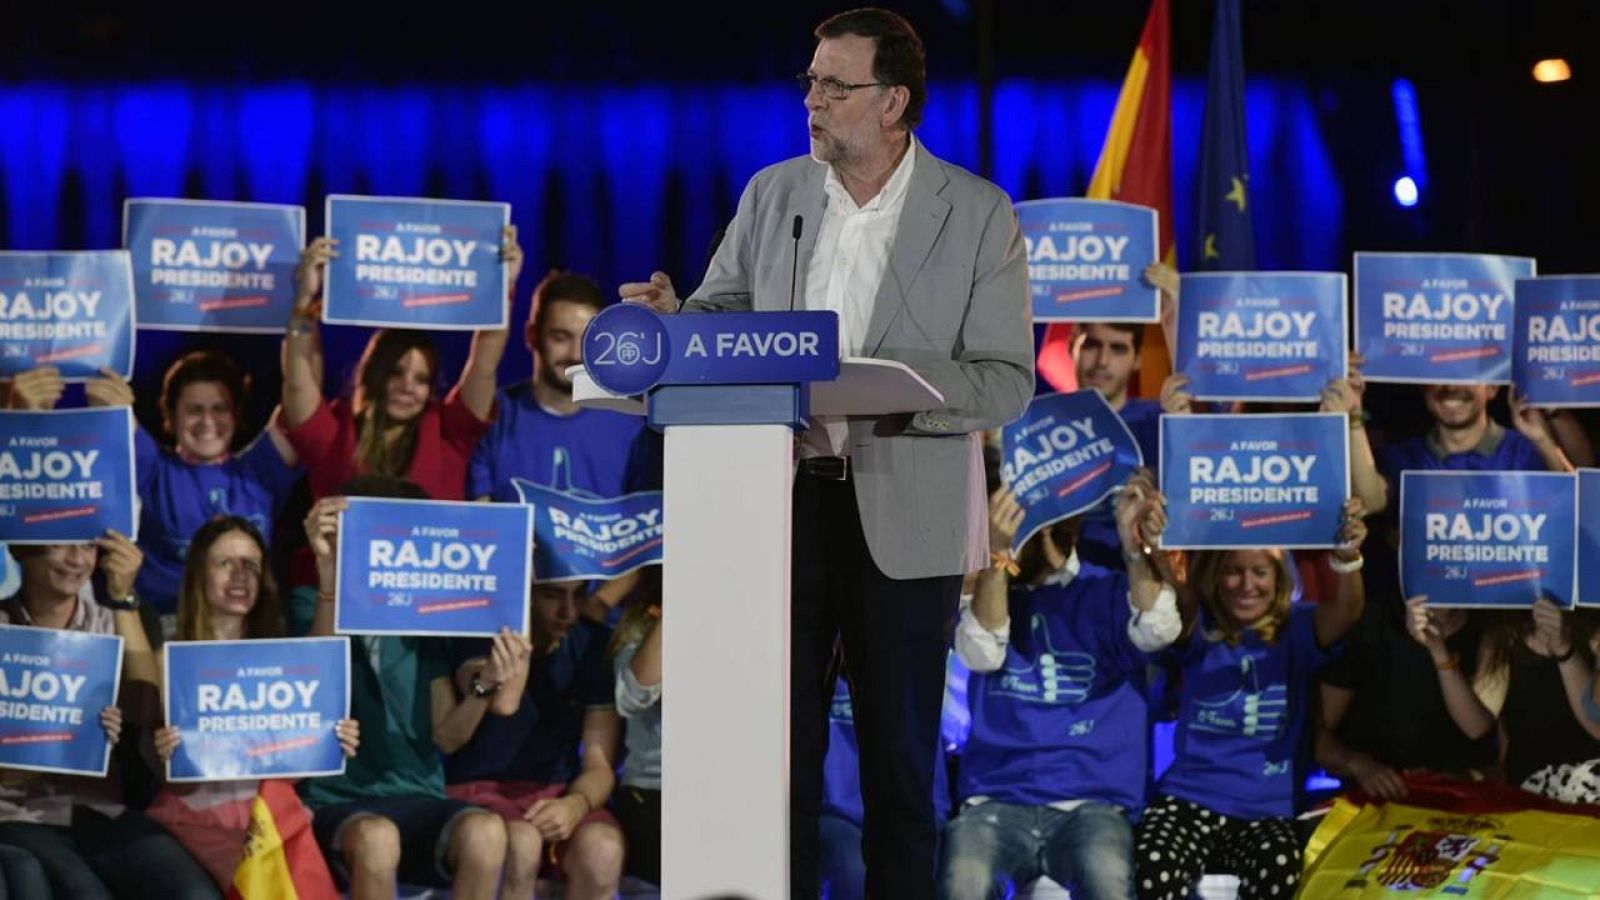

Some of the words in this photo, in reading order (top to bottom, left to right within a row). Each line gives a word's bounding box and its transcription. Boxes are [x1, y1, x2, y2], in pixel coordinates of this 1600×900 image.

[151, 238, 274, 270] RAJOY
[356, 235, 477, 267] RAJOY
[151, 269, 275, 291] PRESIDENTE
[356, 265, 478, 287] PRESIDENTE
[1382, 292, 1504, 321] RAJOY
[0, 321, 106, 340] RESIDENTE
[1198, 311, 1317, 339] RAJOY
[1384, 322, 1506, 341] PRESIDENTE
[684, 333, 708, 358] A
[716, 331, 819, 358] FAVOR
[1198, 340, 1318, 359] PRESIDENTE
[0, 450, 99, 480] AJOY
[1190, 455, 1317, 484] RAJOY
[0, 482, 103, 500] ESIDENTE
[1191, 486, 1319, 504] PRESIDENTE
[548, 506, 660, 542] RAJOY
[1425, 513, 1546, 542] RAJOY
[369, 539, 497, 571] RAJOY
[1426, 544, 1549, 562] PRESIDENTE
[369, 571, 497, 592] PRESIDENTE
[197, 680, 320, 712] RAJOY
[198, 712, 321, 733] PRESIDENTE
